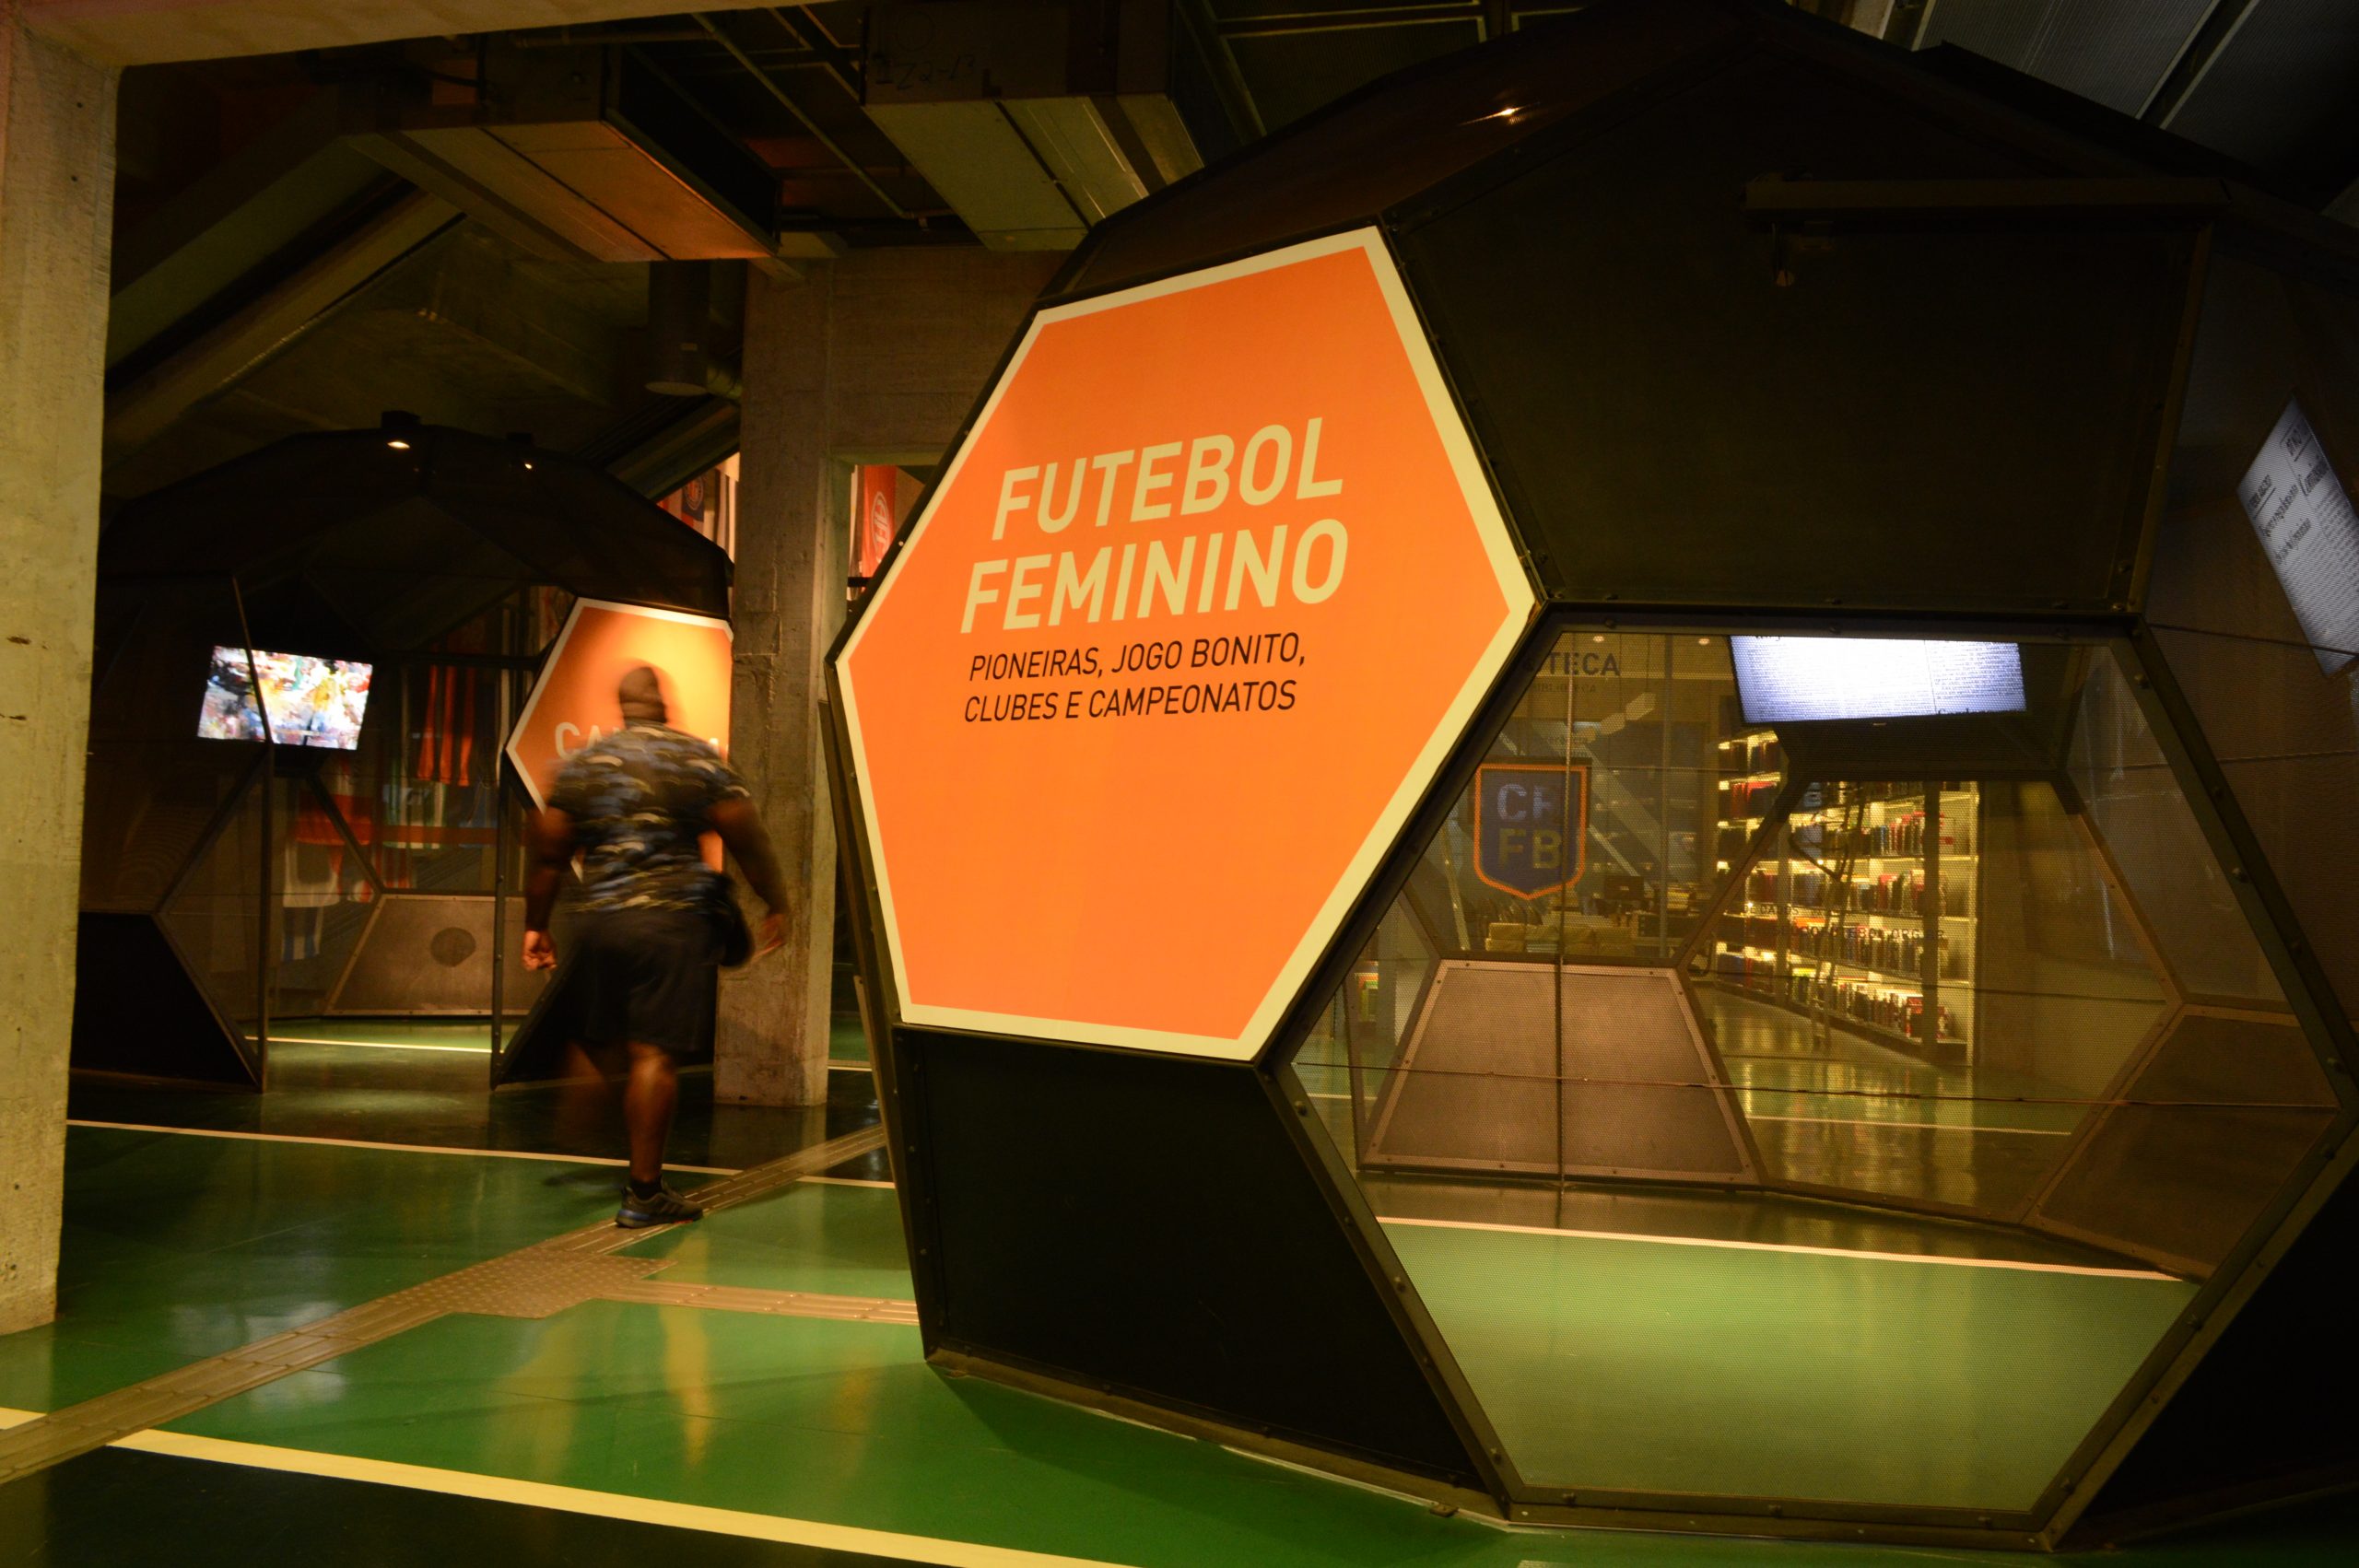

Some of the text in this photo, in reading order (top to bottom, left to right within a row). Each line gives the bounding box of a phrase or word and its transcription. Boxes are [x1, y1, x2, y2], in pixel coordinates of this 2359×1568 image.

[992, 417, 1344, 541] FUTEBOL
[960, 519, 1349, 634] FEMININO
[969, 632, 1306, 682] PIONEIRAS, JOGO BONITO,
[964, 680, 1297, 722] CLUBES E CAMPEONATOS
[1498, 828, 1563, 869] FB
